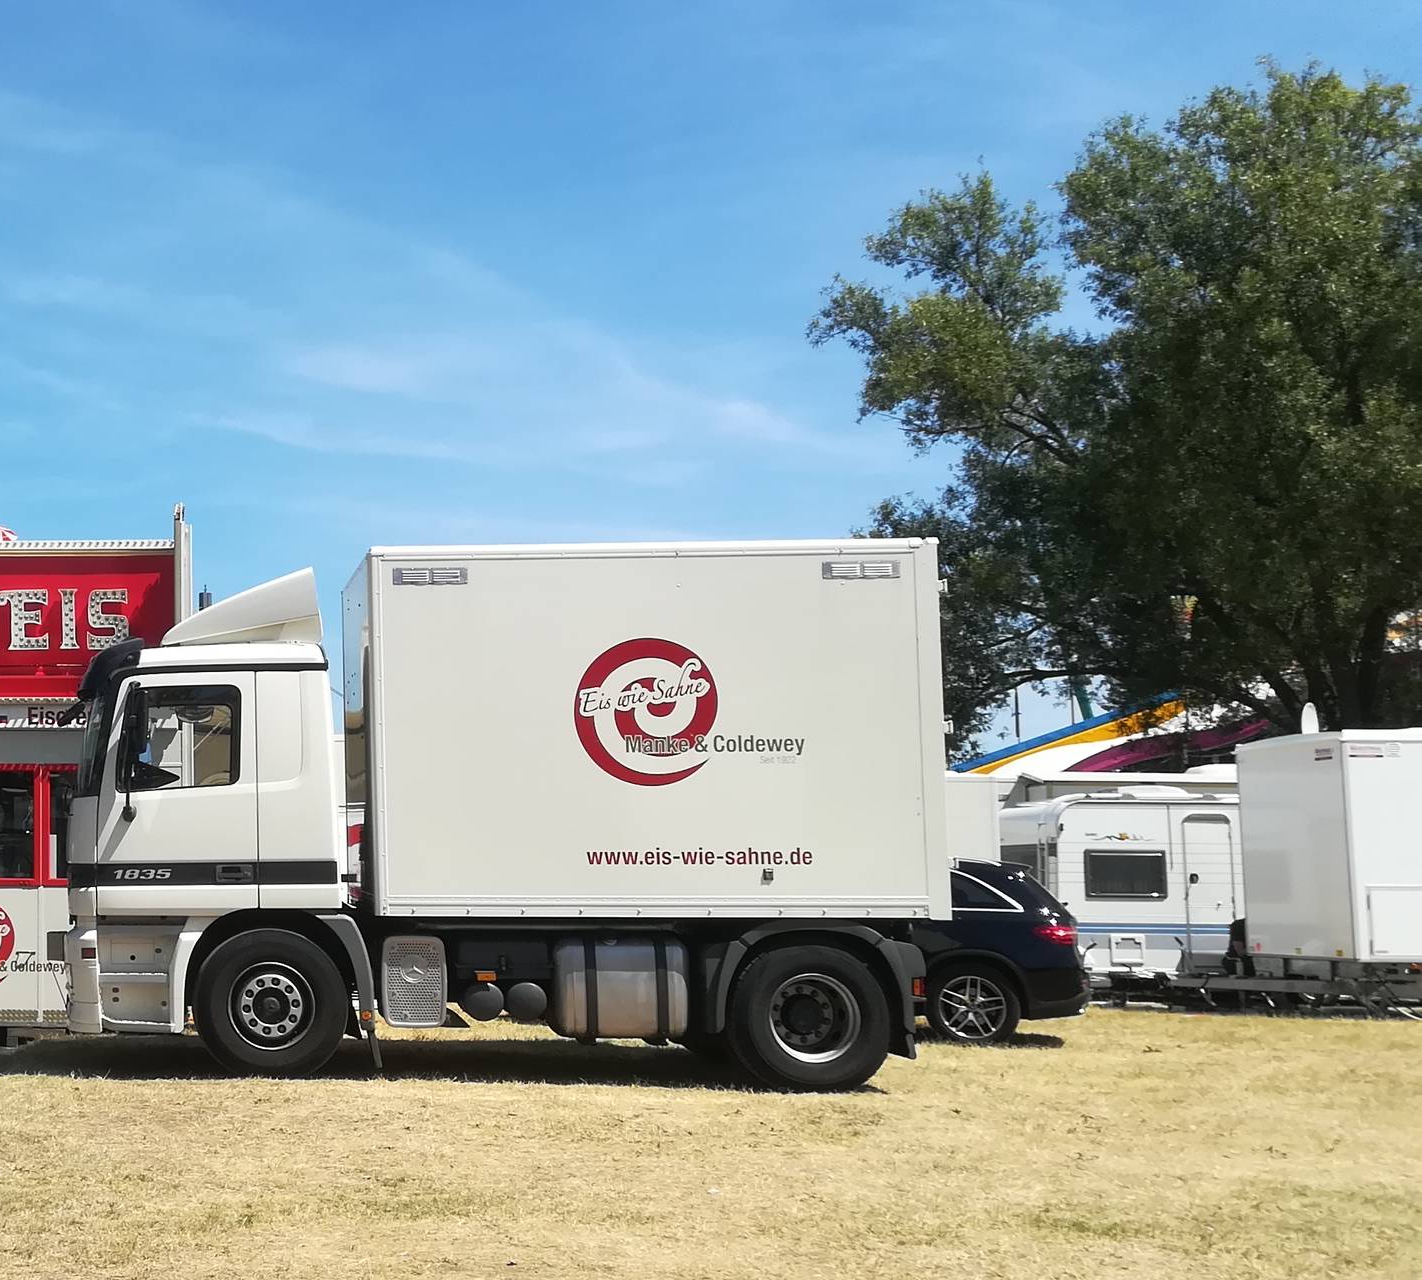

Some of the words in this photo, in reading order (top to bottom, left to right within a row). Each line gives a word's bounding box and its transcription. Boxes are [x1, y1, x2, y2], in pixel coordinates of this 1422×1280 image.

[582, 690, 612, 713] Eis
[618, 686, 649, 707] wie
[652, 662, 706, 700] Sahne
[625, 735, 691, 753] Manke
[694, 735, 709, 753] &
[713, 735, 806, 756] Coldewey
[586, 847, 813, 865] www.eis-wie-sahne.de
[113, 868, 172, 880] 1835
